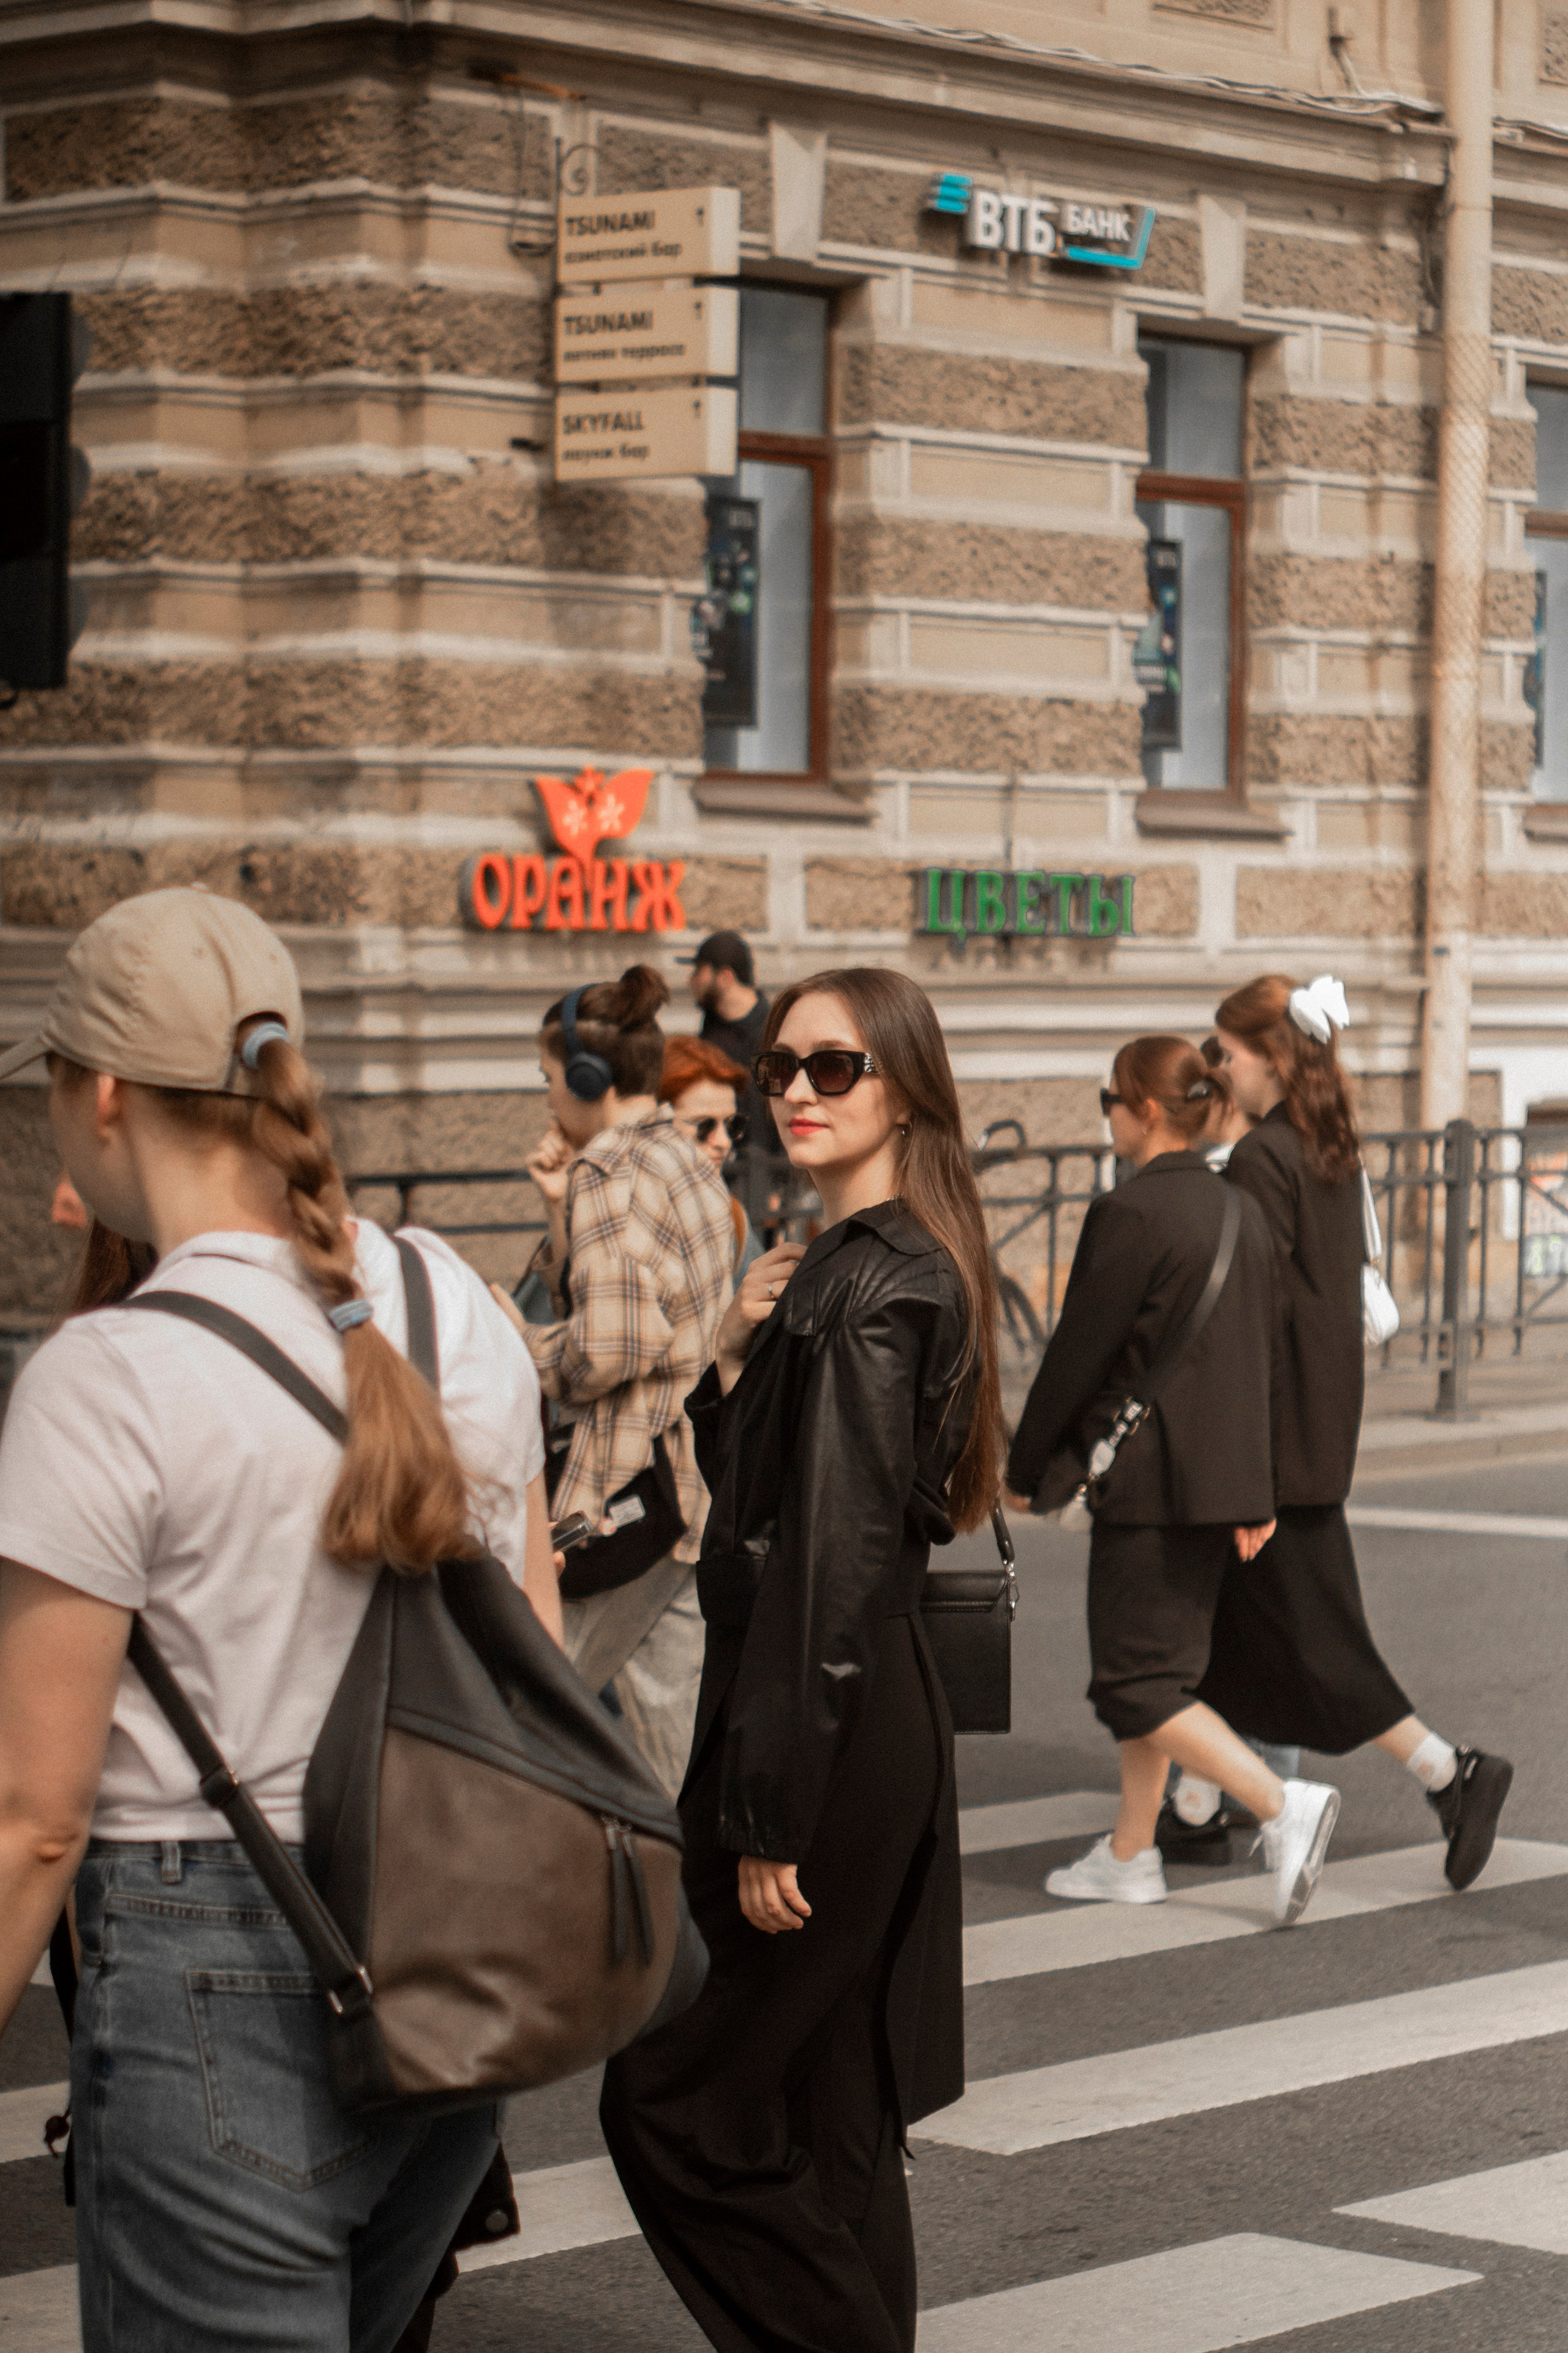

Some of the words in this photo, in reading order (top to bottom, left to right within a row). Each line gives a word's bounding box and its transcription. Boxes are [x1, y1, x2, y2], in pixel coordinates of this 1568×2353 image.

[565, 210, 655, 236] TSUNAMI
[970, 189, 1058, 254] ВТБ
[1064, 203, 1130, 241] БАНК
[651, 241, 682, 259] бар
[564, 311, 653, 335] TSUNAMI
[563, 410, 643, 434] SKYFALL
[619, 444, 650, 461] бар
[472, 853, 686, 932] ОРАНЖ
[926, 869, 1134, 942] ЦВЕТЫ
